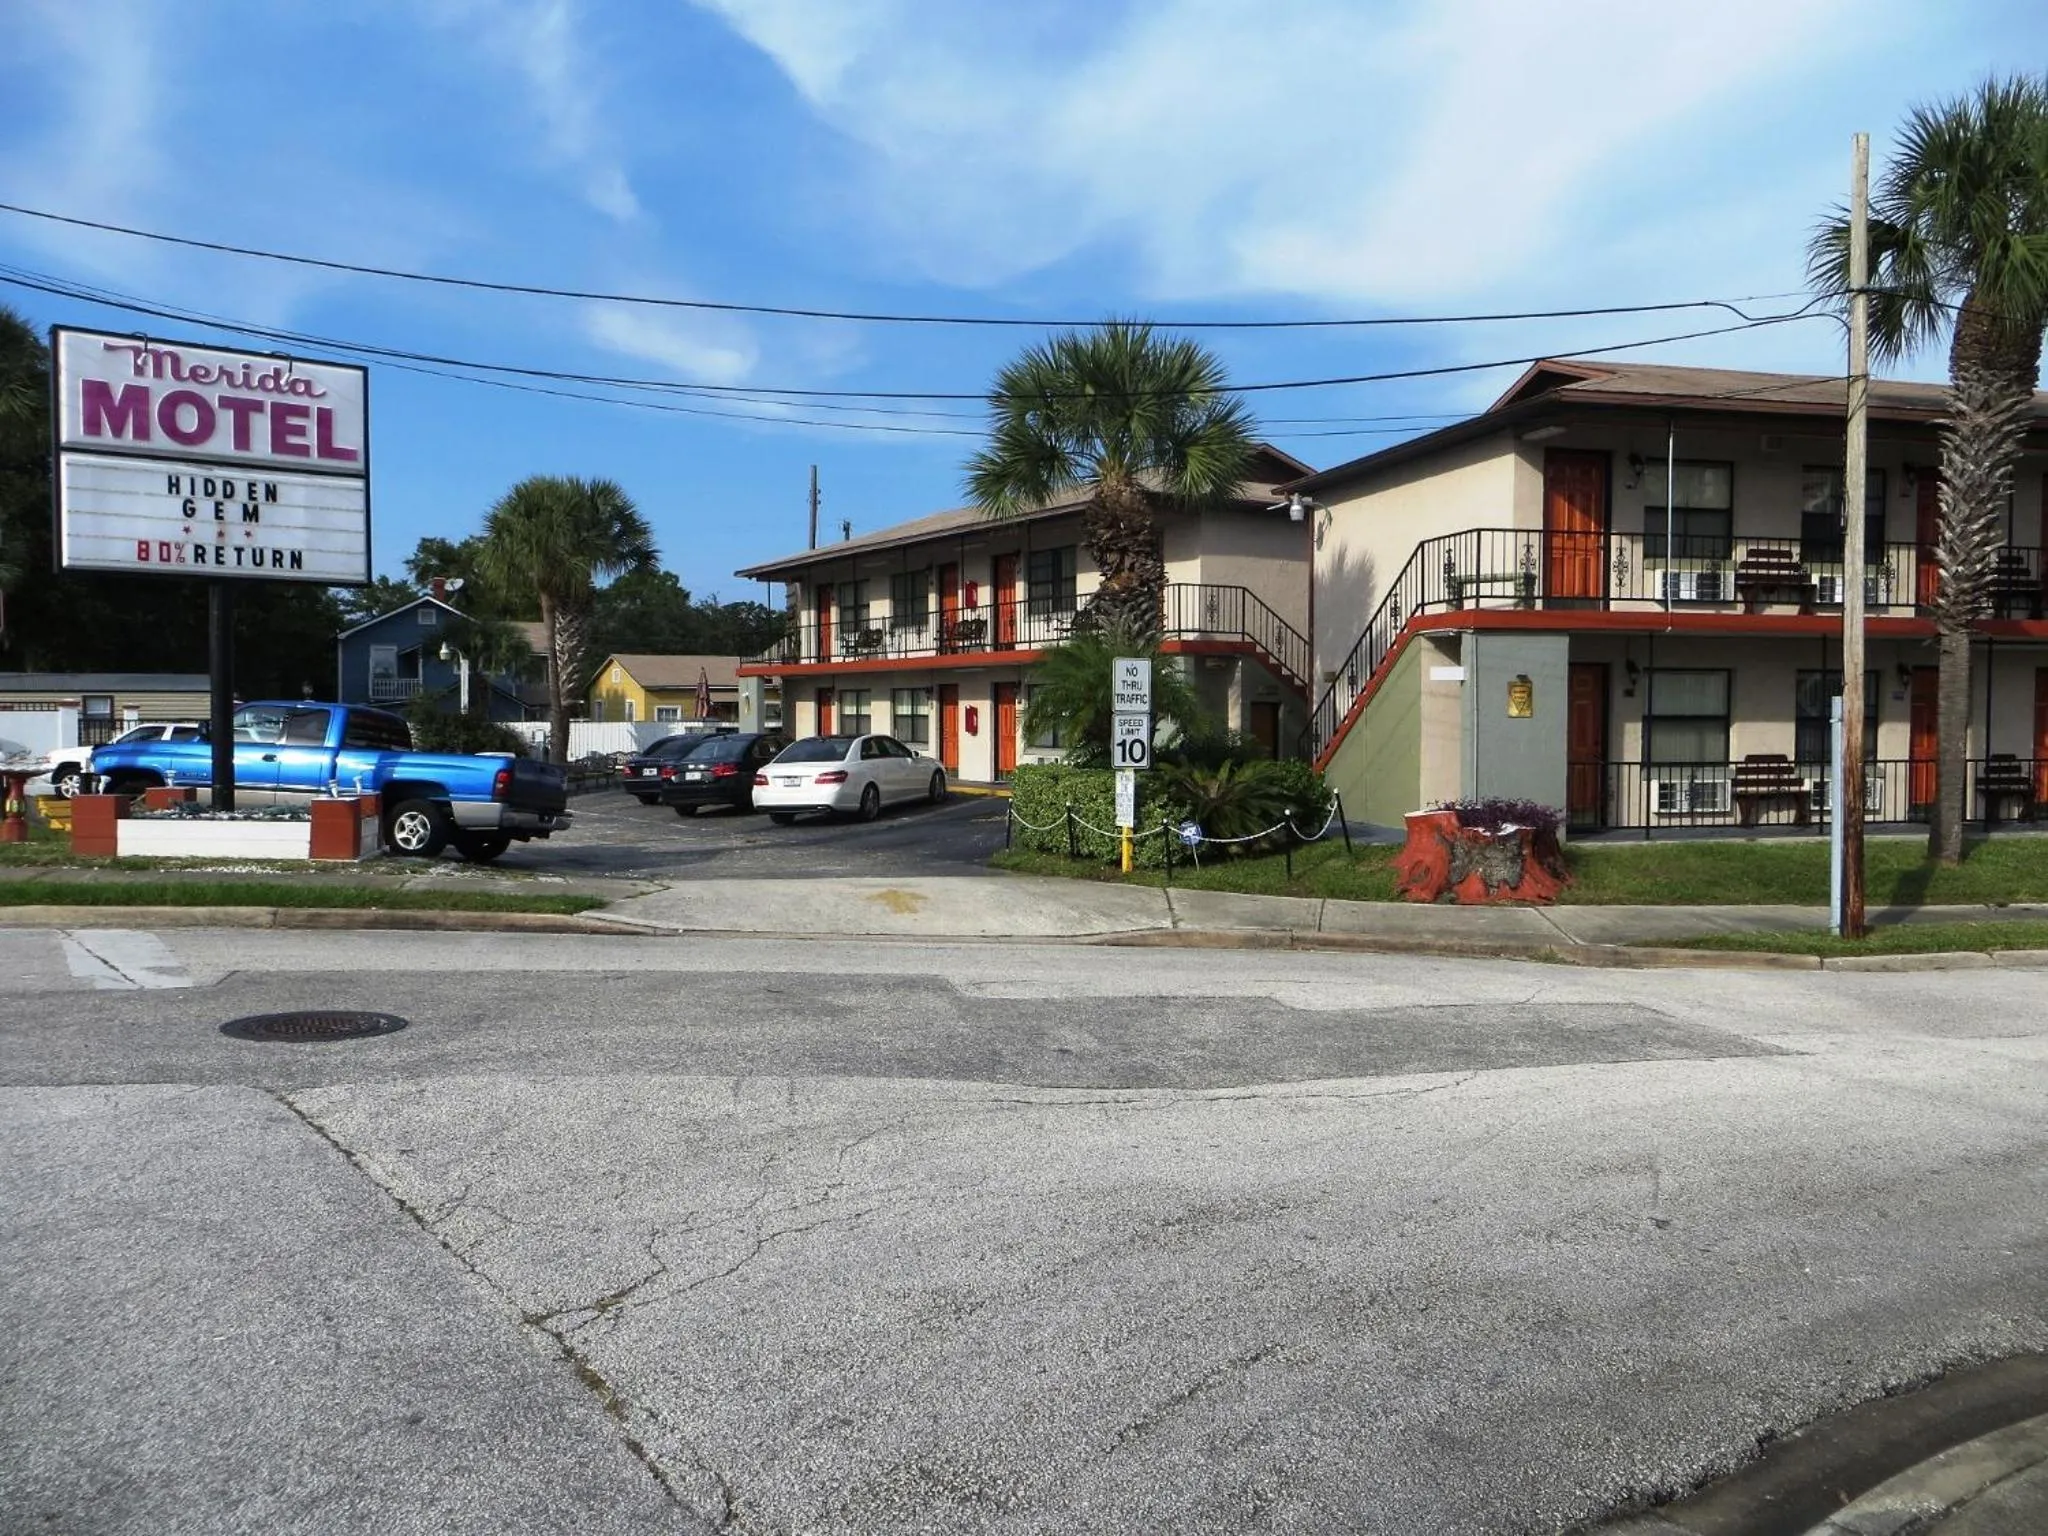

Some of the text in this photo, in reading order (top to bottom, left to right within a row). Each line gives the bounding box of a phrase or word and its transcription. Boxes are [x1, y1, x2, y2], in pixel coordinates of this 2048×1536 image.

[103, 342, 327, 398] Merida
[81, 378, 358, 461] MOTEL
[167, 475, 278, 503] HIDDEN
[182, 499, 260, 523] GEM
[193, 544, 303, 570] RETURN
[1126, 667, 1138, 677] NO
[1121, 680, 1142, 690] THRU
[1115, 694, 1147, 704] TRAFFIC
[1119, 719, 1144, 727] SPEED
[1121, 728, 1140, 736] LIMIT
[1116, 739, 1145, 763] 10
